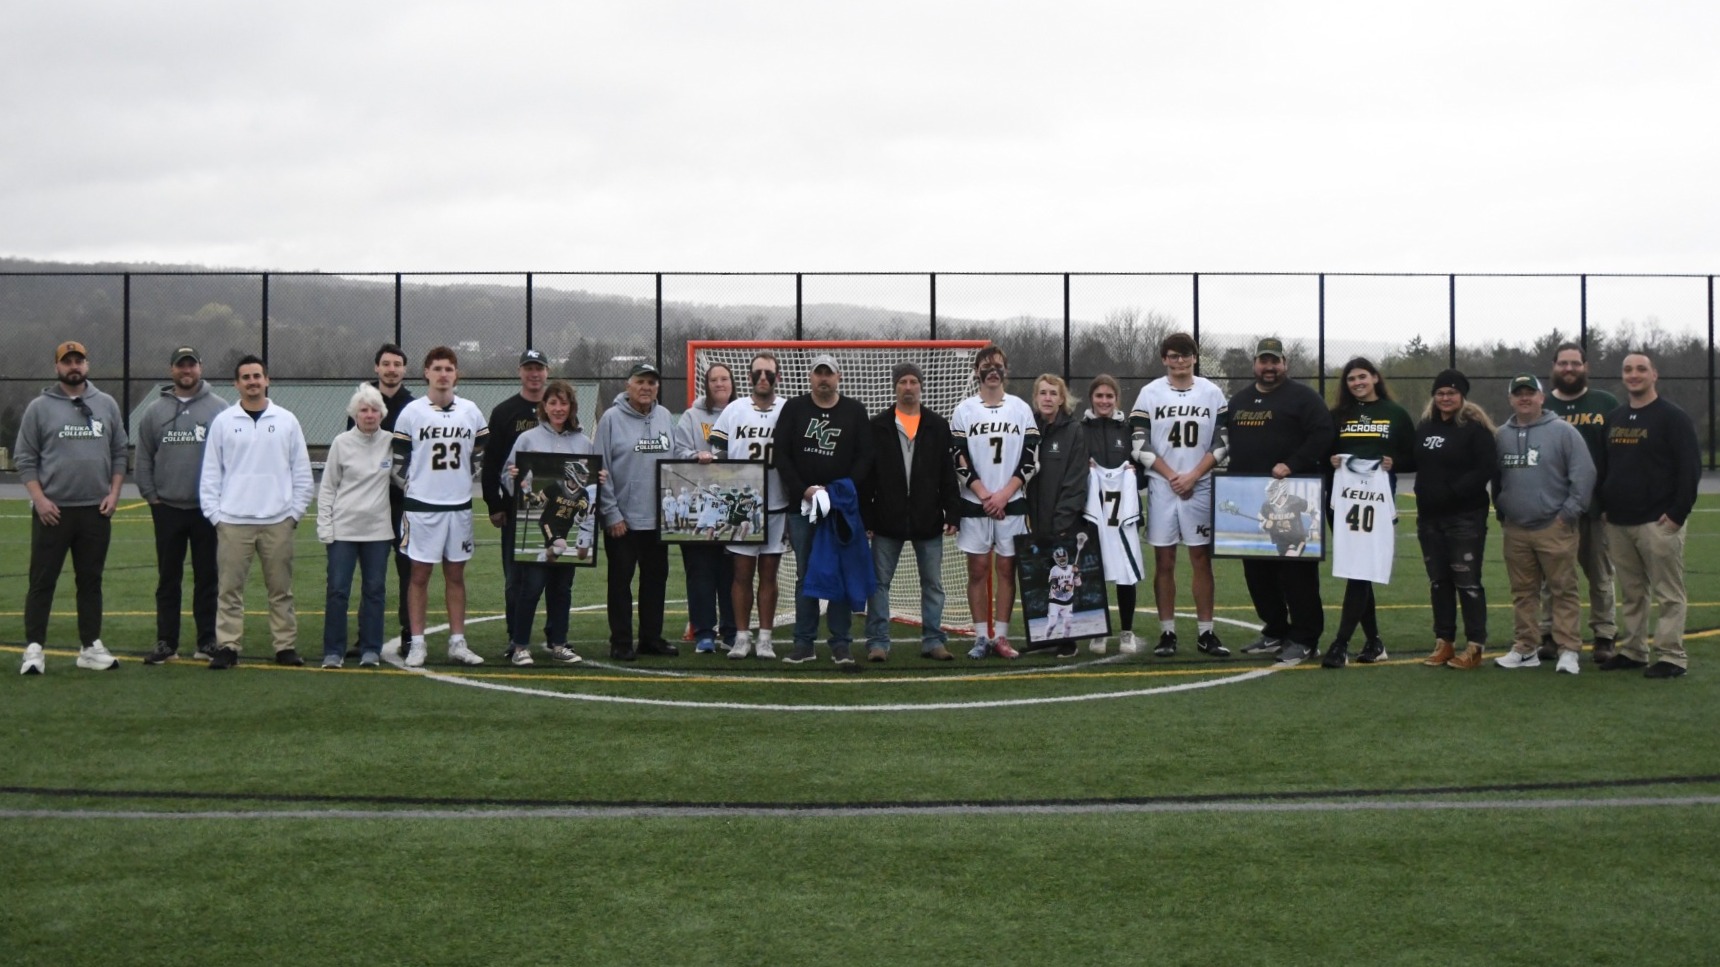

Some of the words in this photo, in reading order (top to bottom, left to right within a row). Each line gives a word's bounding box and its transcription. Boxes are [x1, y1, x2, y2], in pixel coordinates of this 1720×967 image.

[1154, 405, 1211, 420] KEUKA
[1232, 410, 1272, 420] KEUKA
[1558, 413, 1605, 426] UKA
[58, 430, 93, 438] COLLEGE
[419, 425, 472, 441] KEUKA
[735, 425, 775, 439] KEU
[804, 417, 842, 450] KC
[968, 422, 1021, 437] KEUKA
[1167, 420, 1199, 448] 40
[1340, 424, 1390, 433] LACROSSE
[634, 444, 662, 452] COLLEGE
[803, 447, 834, 456] LACROSSE
[989, 436, 1003, 464] 7
[432, 442, 462, 470] 23
[1341, 486, 1385, 503] KEUKA
[1104, 491, 1122, 527] 7
[1345, 503, 1375, 532] 40
